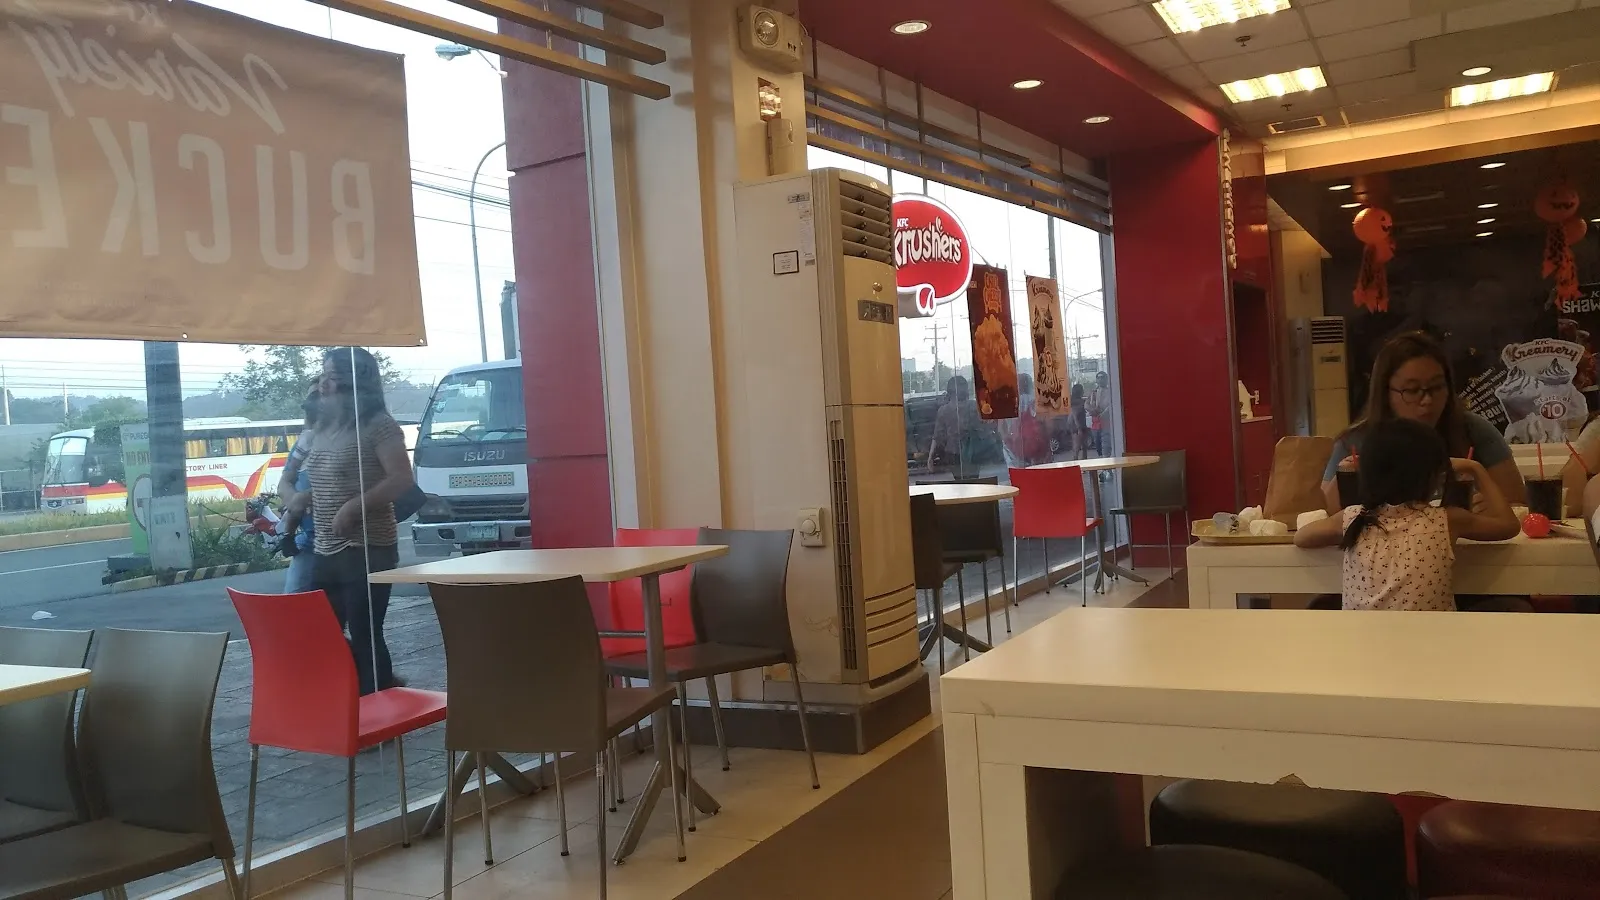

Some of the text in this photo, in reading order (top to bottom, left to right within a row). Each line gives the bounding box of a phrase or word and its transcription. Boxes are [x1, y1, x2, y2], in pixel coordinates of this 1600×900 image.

[896, 217, 909, 228] KFC
[1511, 345, 1579, 362] Kreamery
[464, 450, 505, 461] ISUZU
[209, 463, 228, 471] LINER
